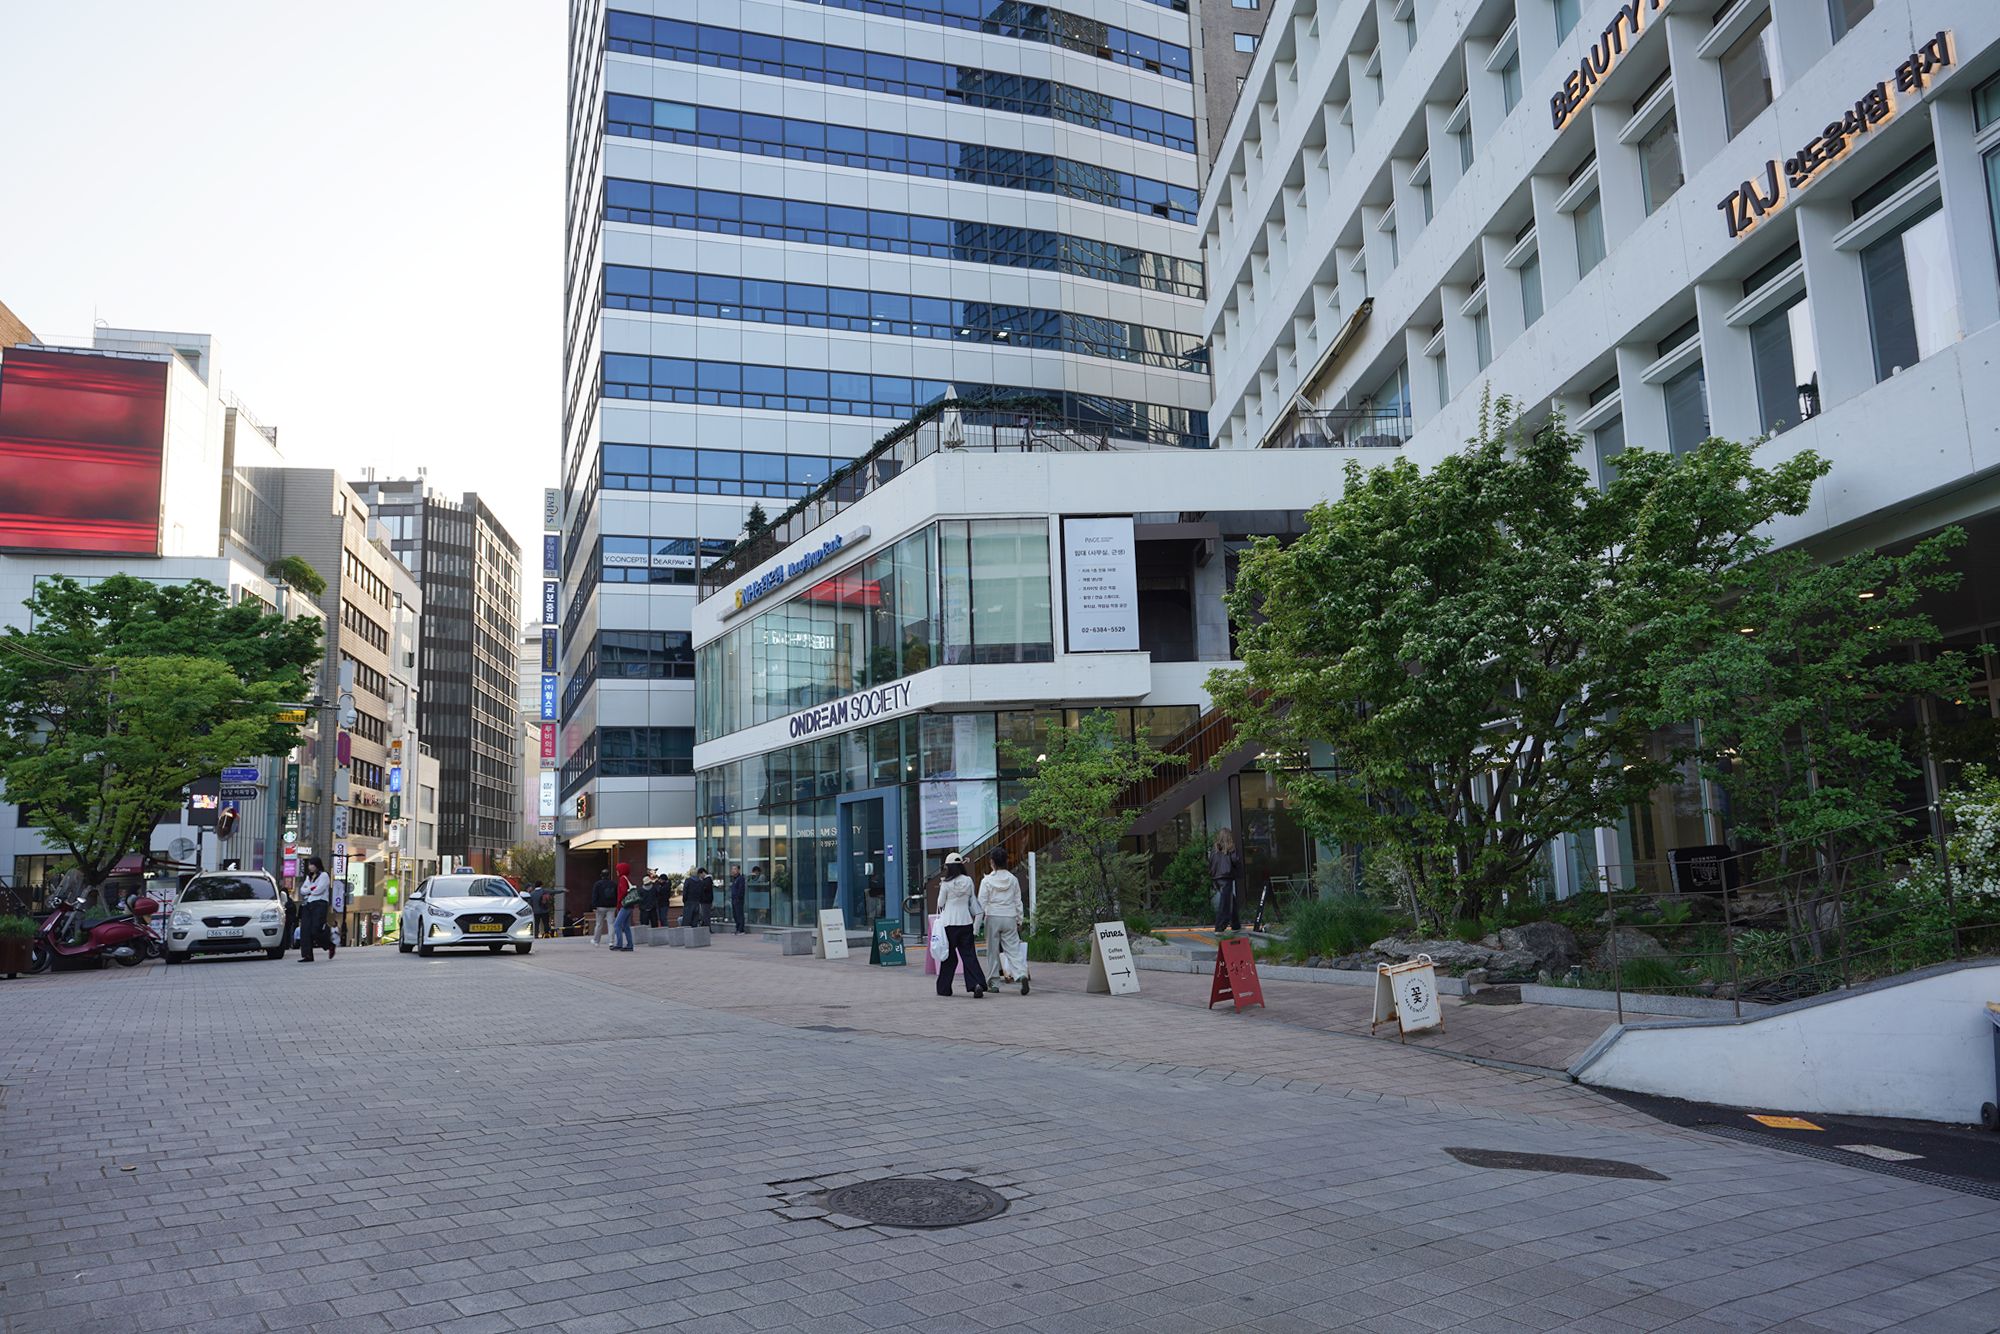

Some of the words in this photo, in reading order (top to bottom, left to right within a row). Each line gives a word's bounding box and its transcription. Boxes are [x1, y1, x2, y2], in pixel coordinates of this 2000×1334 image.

[1550, 0, 1642, 130] BEAUTY
[1717, 159, 1781, 238] TAJ
[1784, 81, 1889, 188] 인도음식점
[1895, 31, 1951, 92] 타지
[546, 583, 555, 623] 교보증권
[789, 700, 848, 739] ONDREAM
[851, 680, 911, 722] SOCIETY
[1410, 986, 1422, 1005] 꽃
